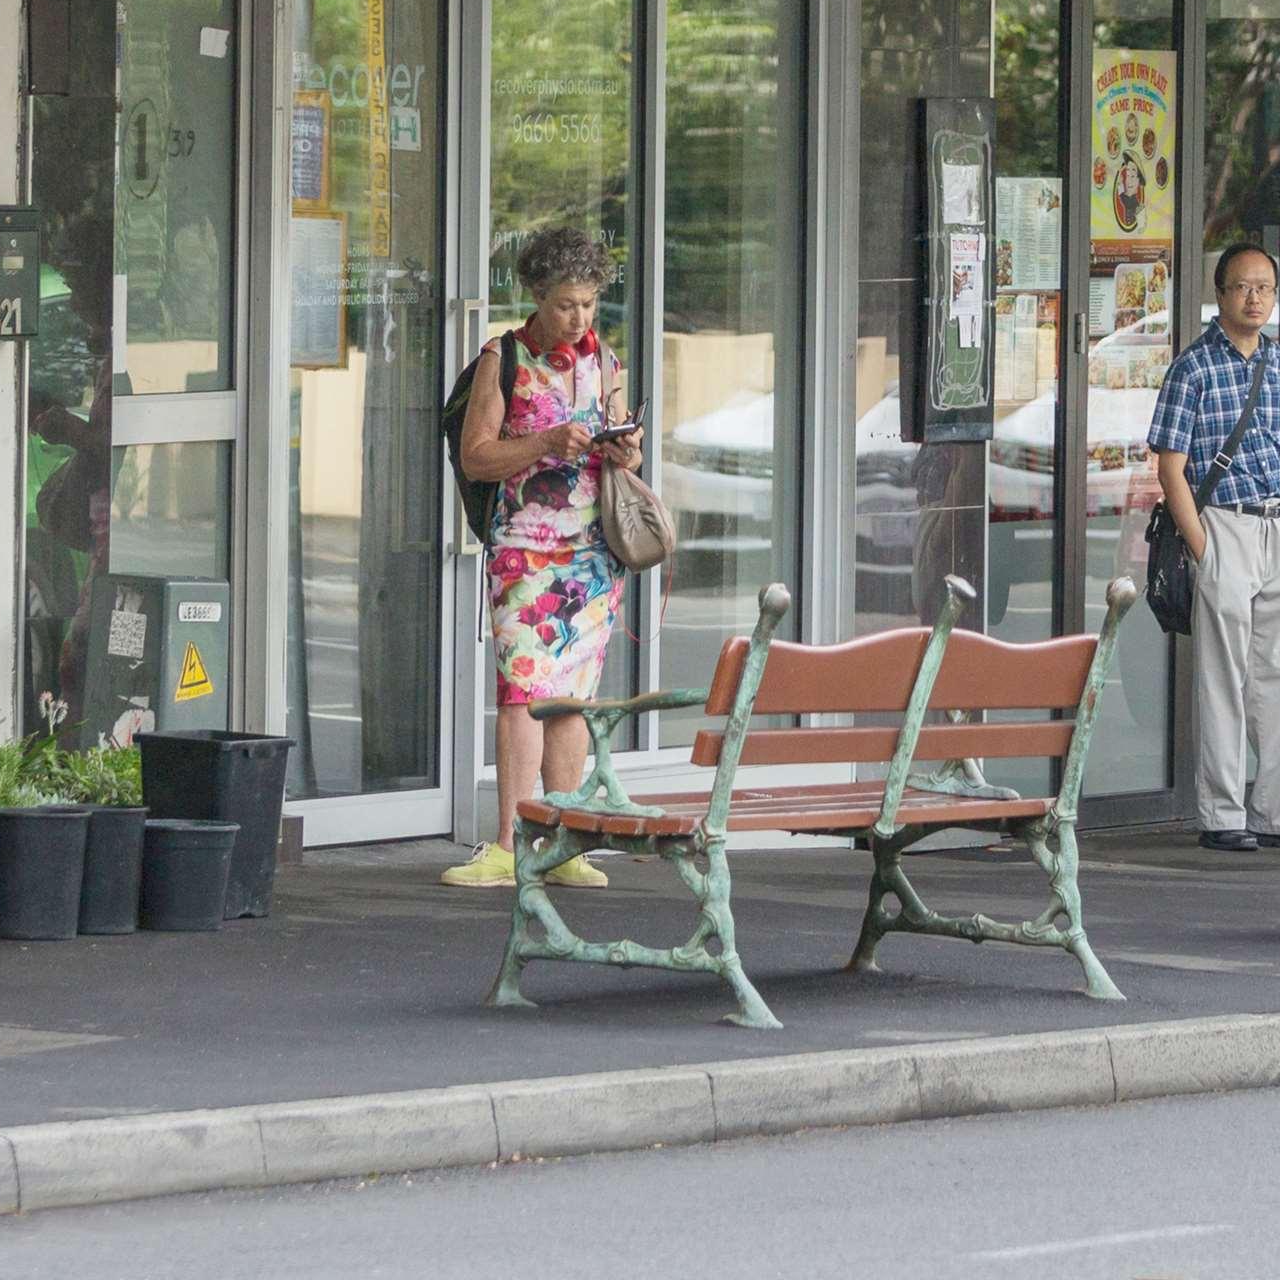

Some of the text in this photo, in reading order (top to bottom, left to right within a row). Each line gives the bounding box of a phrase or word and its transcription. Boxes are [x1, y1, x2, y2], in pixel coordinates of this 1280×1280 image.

[304, 62, 426, 107] ecover
[1096, 64, 1119, 94] CREATE
[1110, 98, 1154, 117] SAME PRICE
[512, 112, 600, 144] 9660 5566
